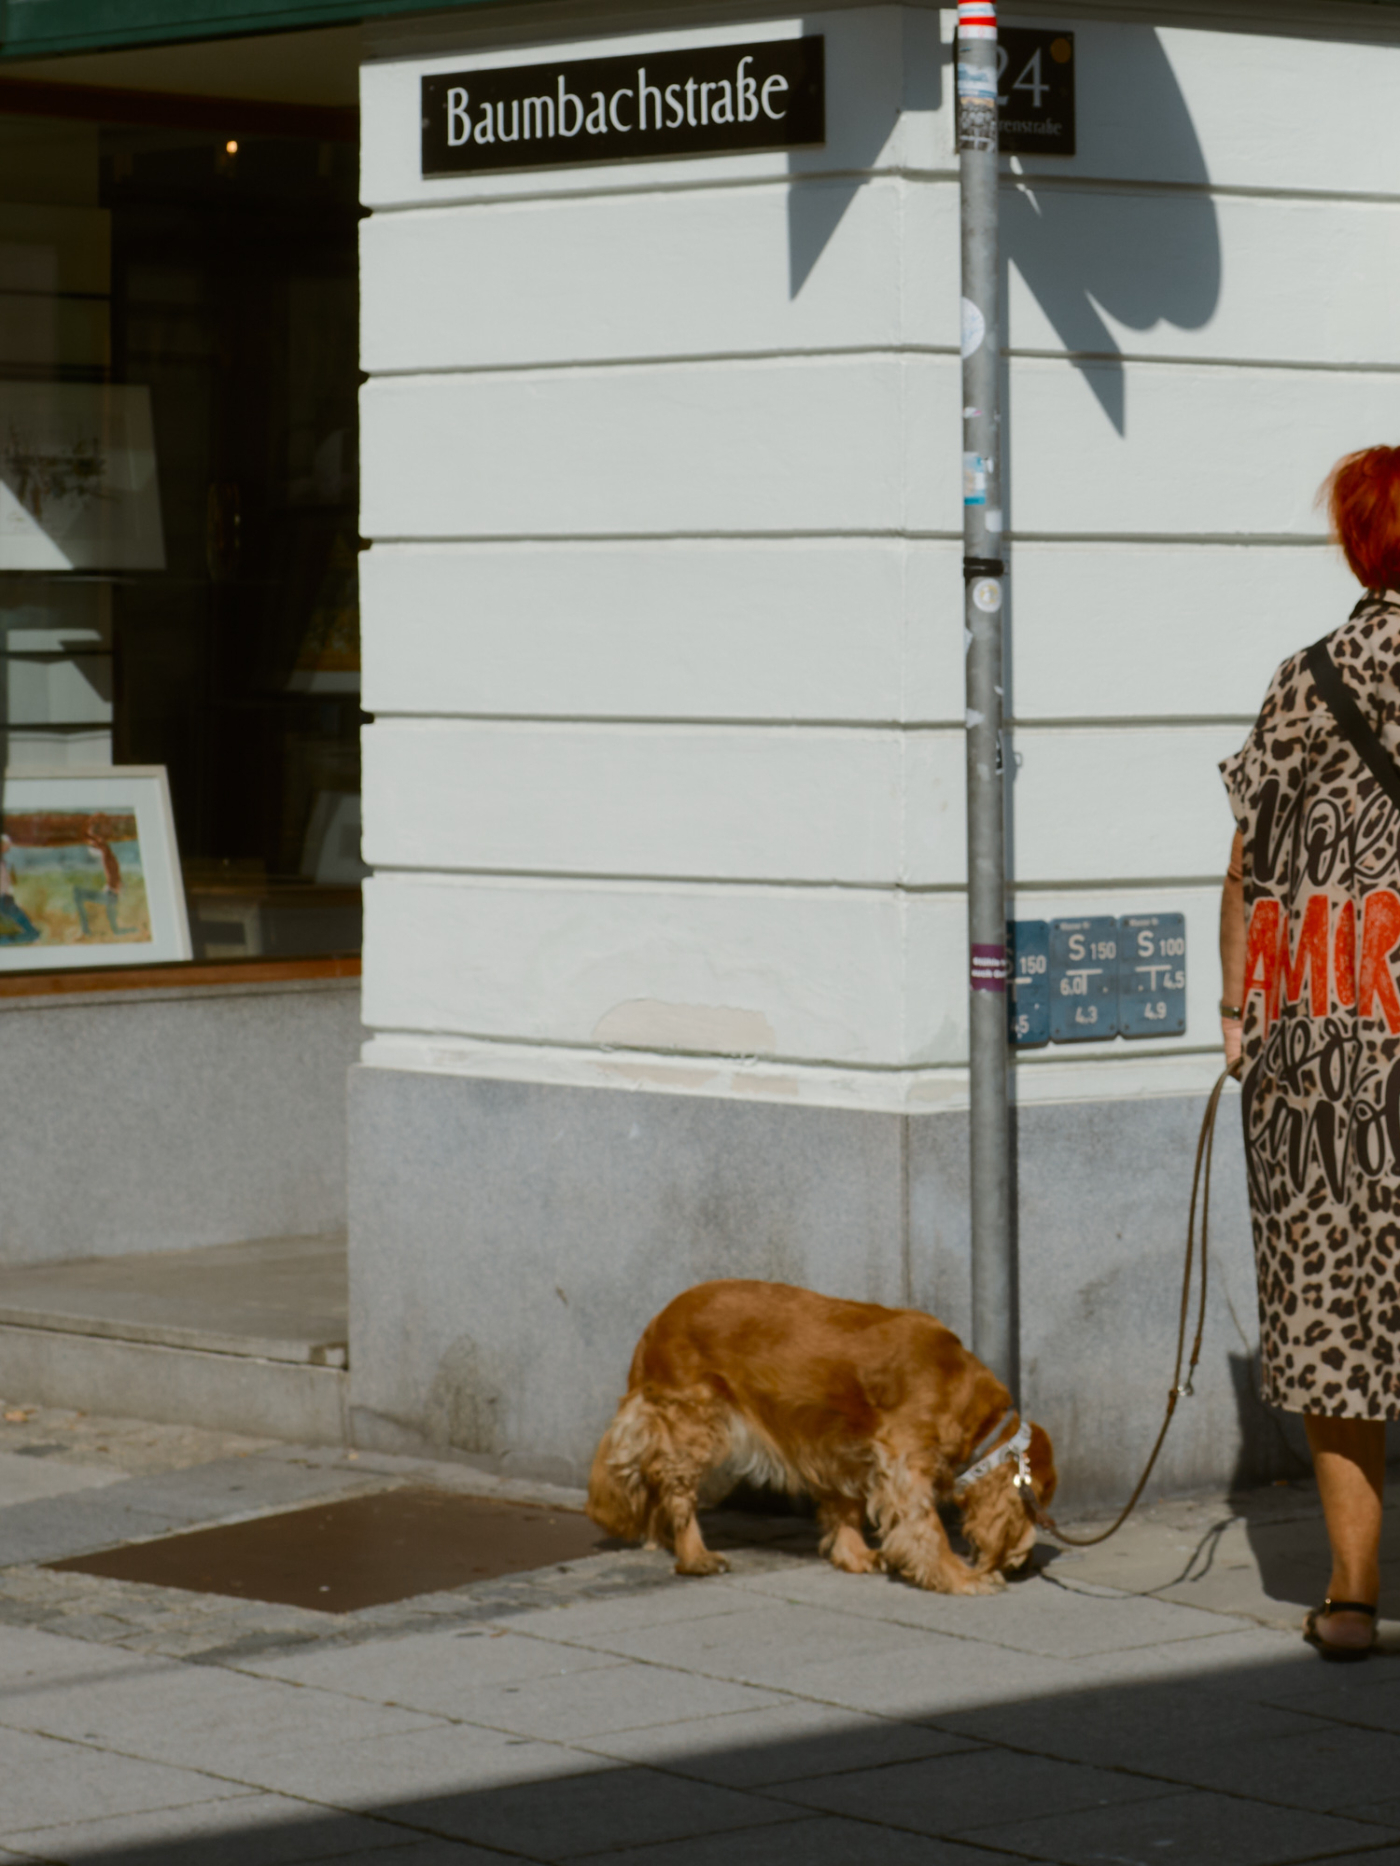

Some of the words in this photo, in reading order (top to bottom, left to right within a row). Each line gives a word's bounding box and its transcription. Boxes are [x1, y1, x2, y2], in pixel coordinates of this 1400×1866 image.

[446, 56, 790, 148] Baumbachstraße
[1090, 941, 1117, 960] 150
[1159, 938, 1185, 957] 100
[1019, 954, 1047, 975] 150
